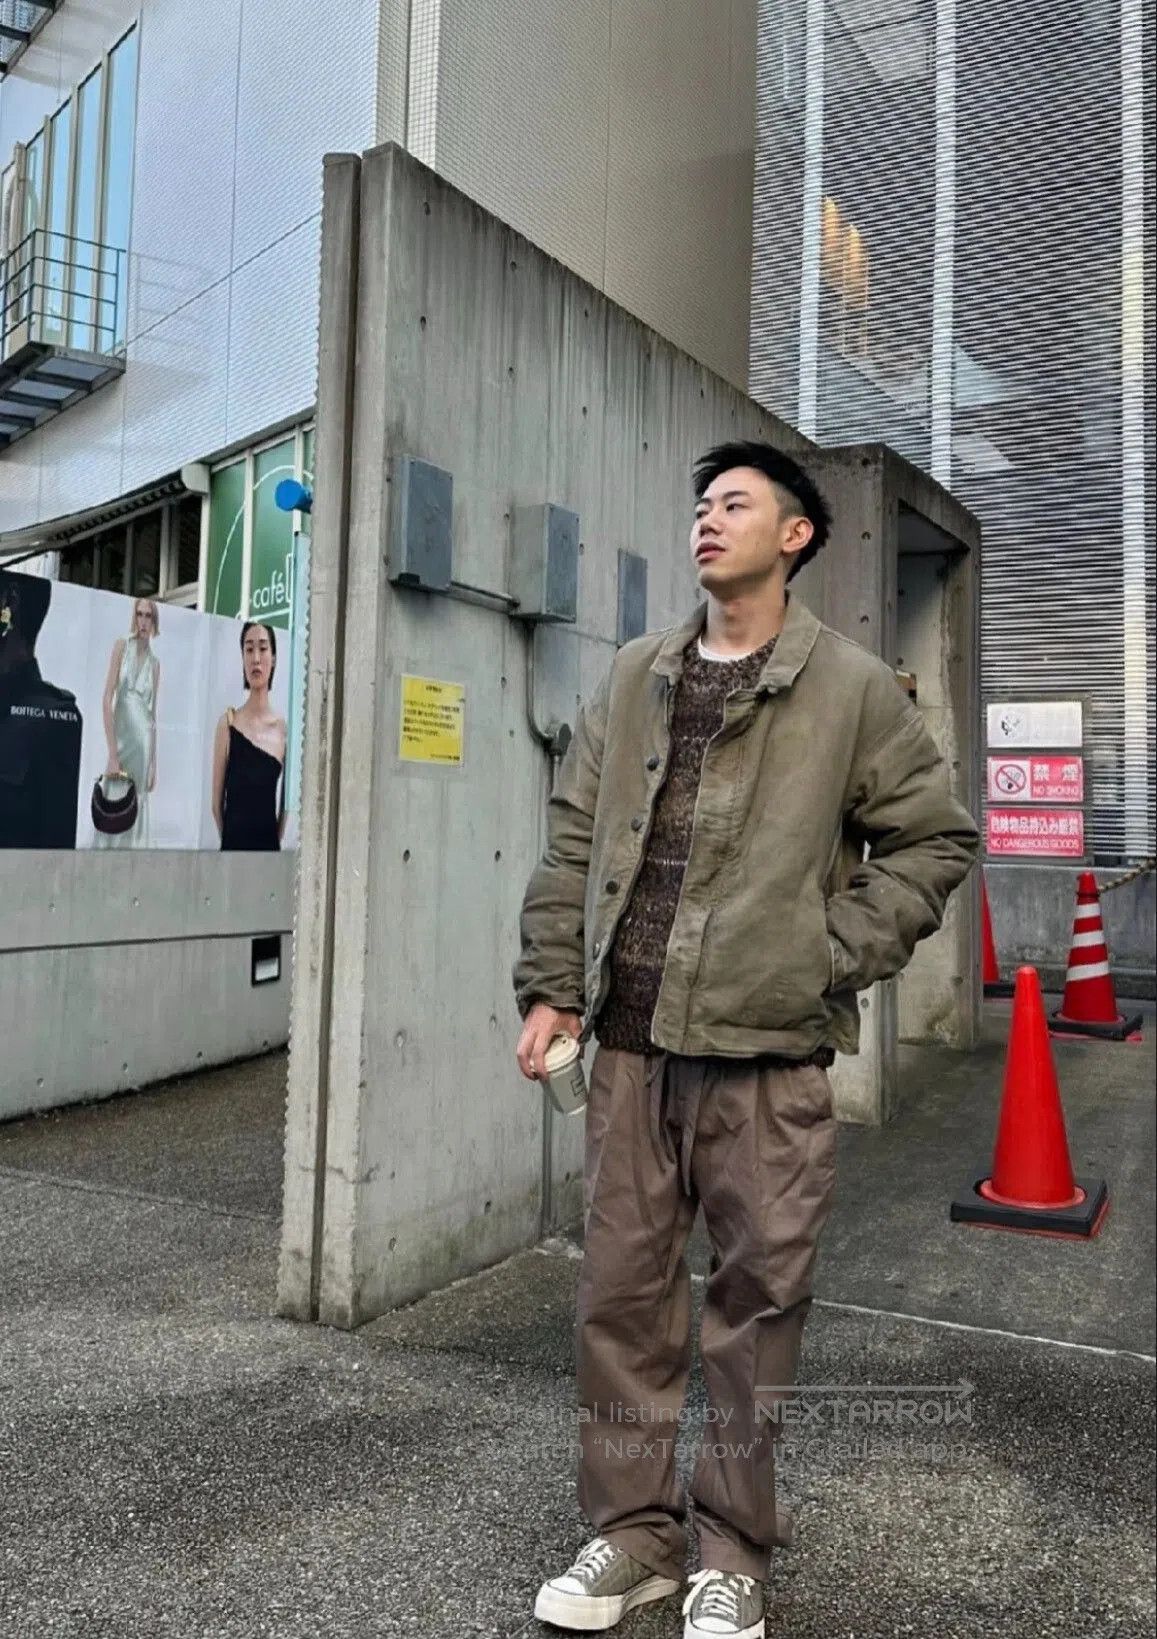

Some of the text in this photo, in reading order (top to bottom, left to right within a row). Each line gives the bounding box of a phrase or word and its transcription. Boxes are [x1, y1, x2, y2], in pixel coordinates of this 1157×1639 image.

[252, 570, 285, 609] café
[10, 705, 79, 722] BOTTEGA VENETA
